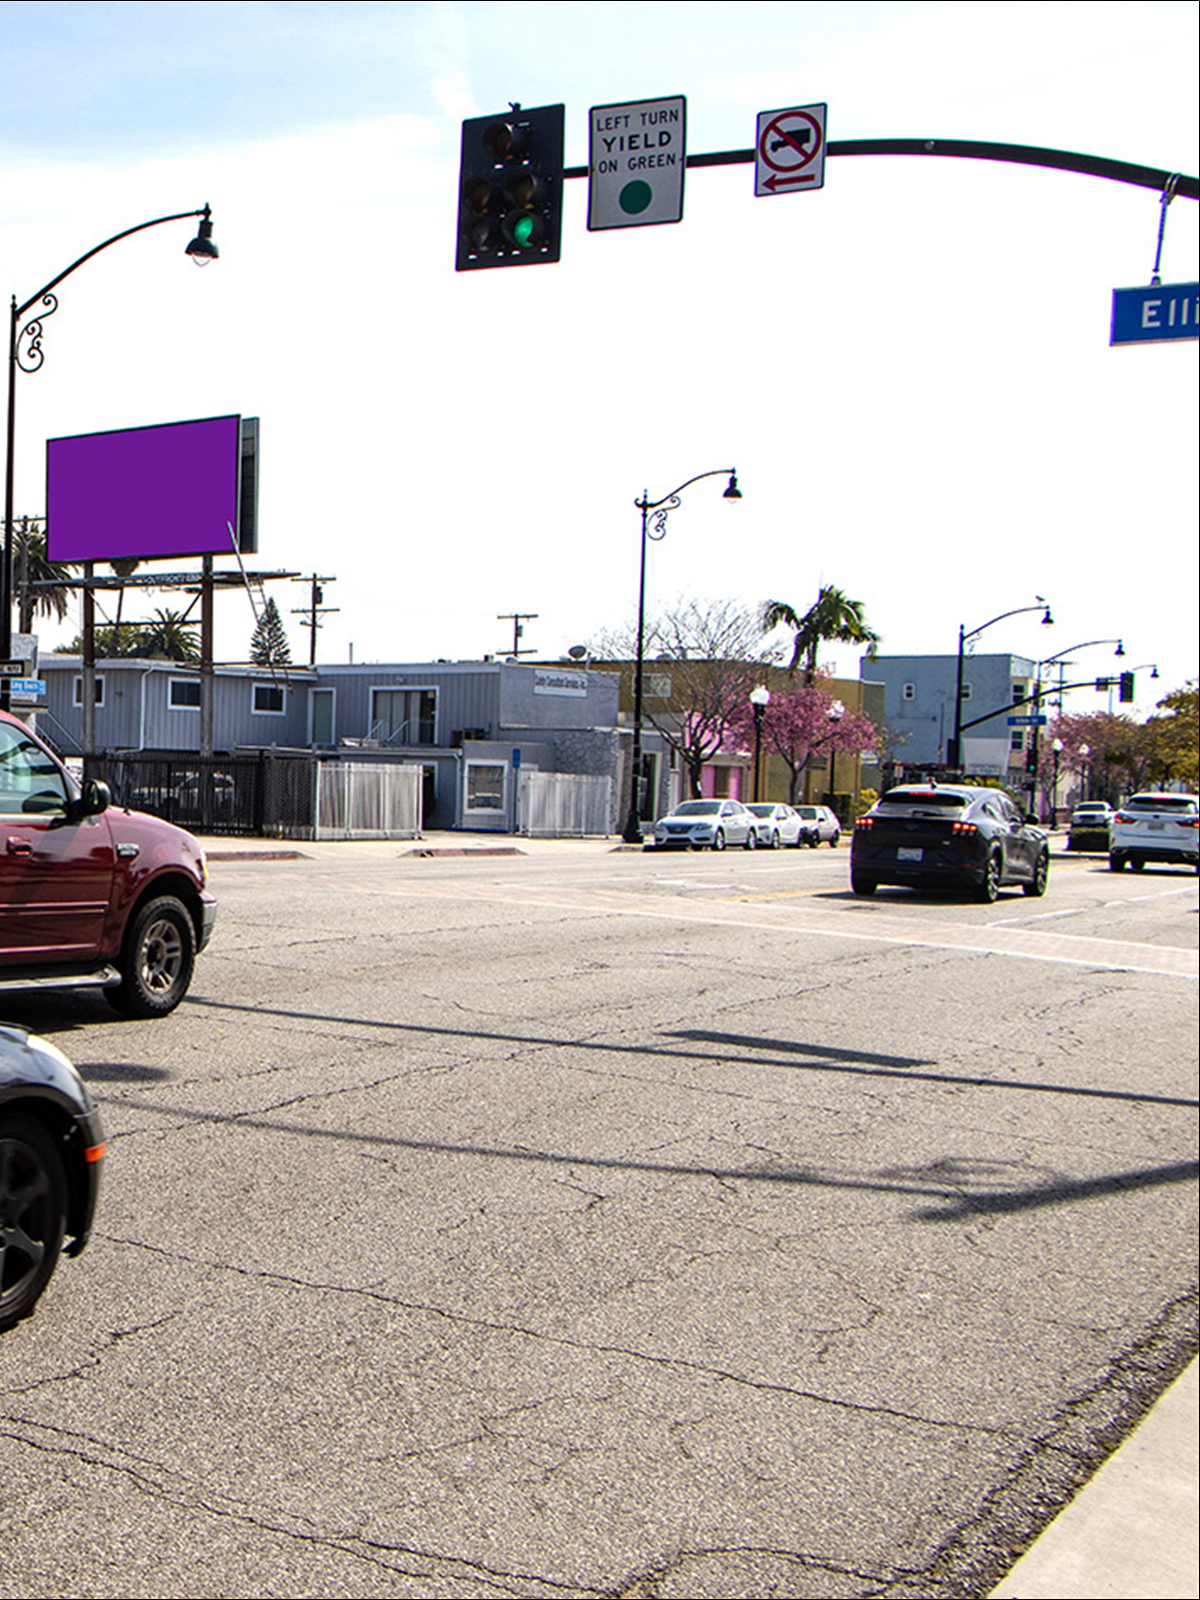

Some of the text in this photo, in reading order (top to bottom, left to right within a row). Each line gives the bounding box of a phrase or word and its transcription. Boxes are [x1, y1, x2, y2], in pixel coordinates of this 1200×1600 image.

[597, 109, 679, 132] LEFT TURN
[602, 130, 672, 153] YIELD
[599, 153, 676, 174] ON GREEN
